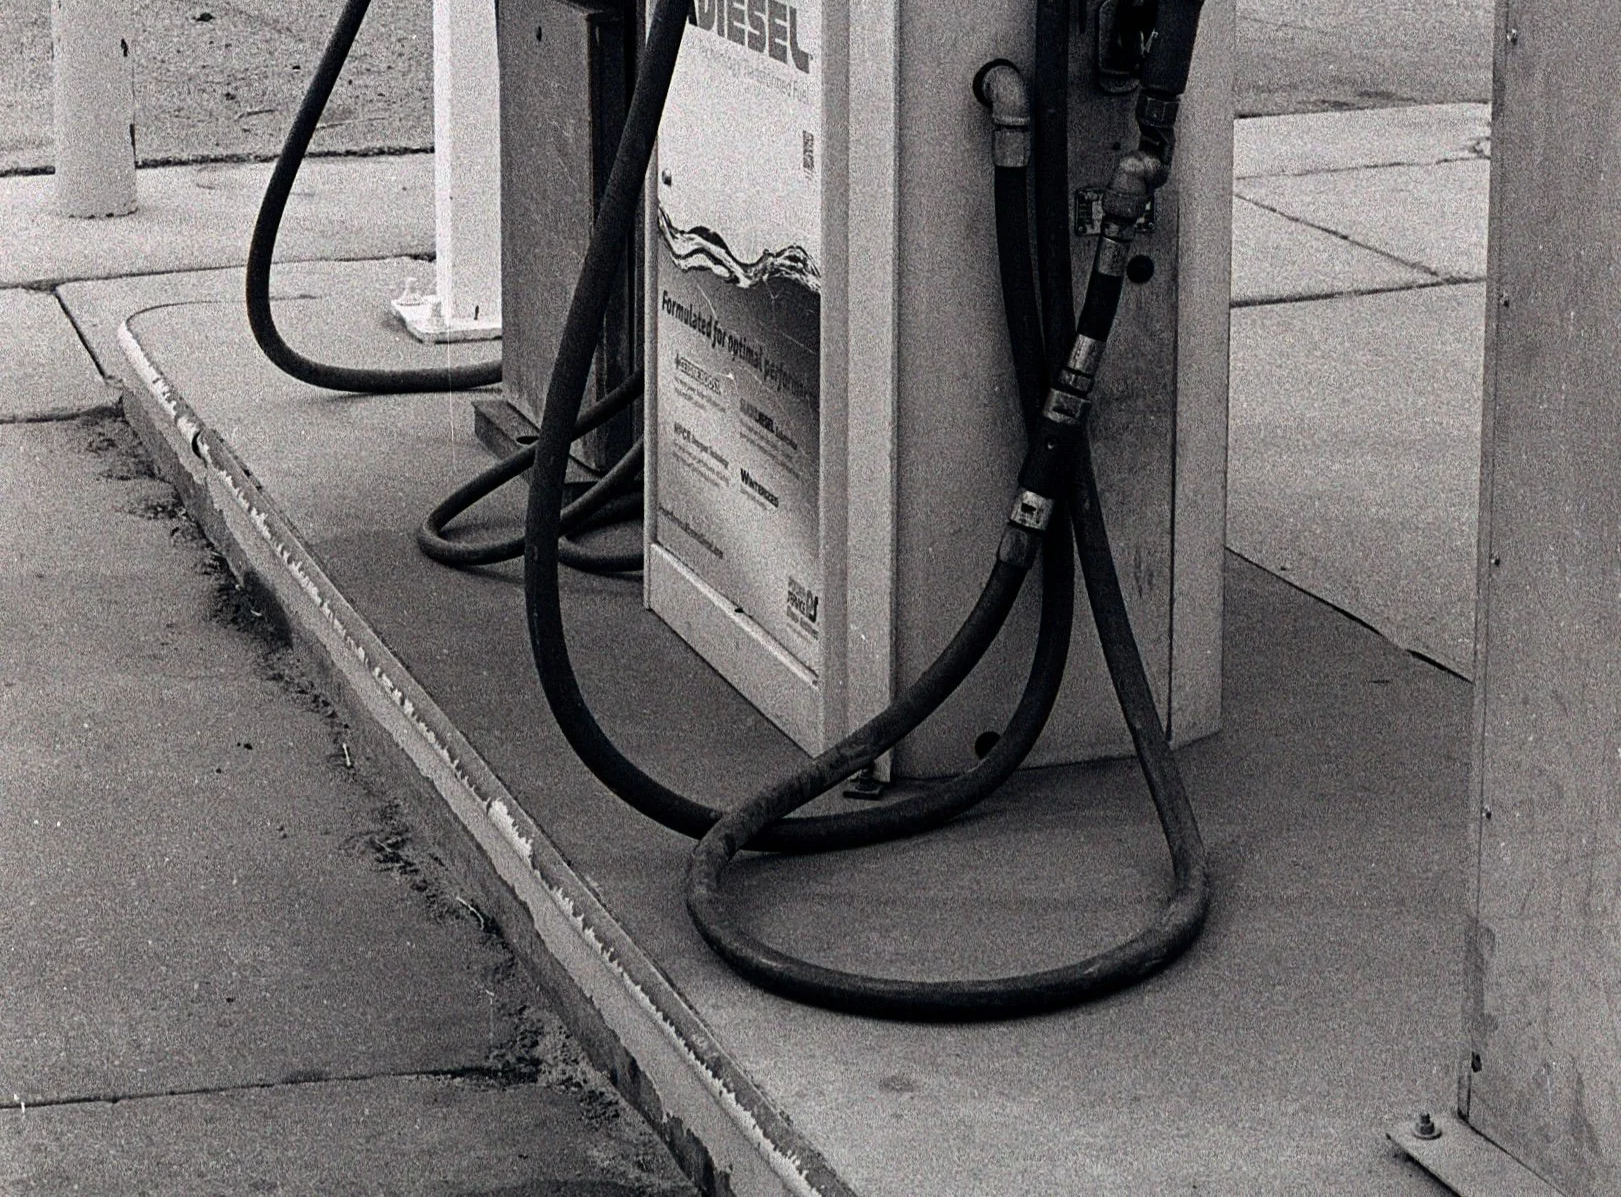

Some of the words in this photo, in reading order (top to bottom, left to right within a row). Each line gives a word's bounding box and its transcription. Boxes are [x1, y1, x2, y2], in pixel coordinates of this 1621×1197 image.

[662, 290, 712, 339] Formulated
[711, 320, 727, 350] for
[728, 334, 763, 373] optimal
